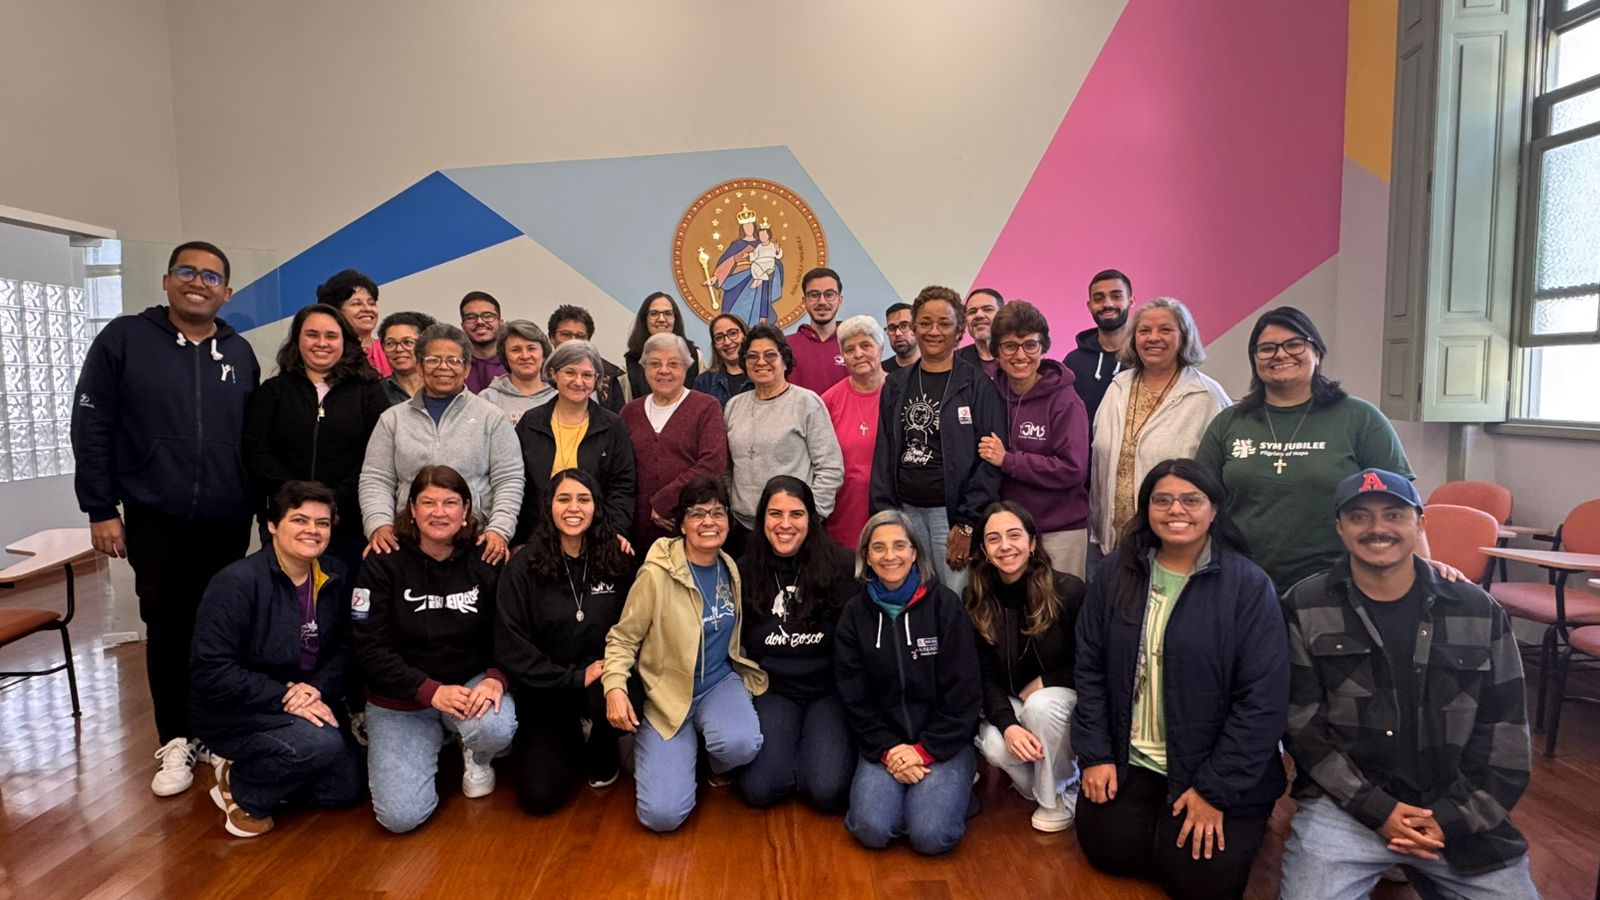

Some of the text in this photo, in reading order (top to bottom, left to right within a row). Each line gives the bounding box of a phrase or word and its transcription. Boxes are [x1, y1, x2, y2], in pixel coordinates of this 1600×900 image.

[1259, 442, 1326, 451] SYM JUBILEE
[1359, 472, 1388, 492] A
